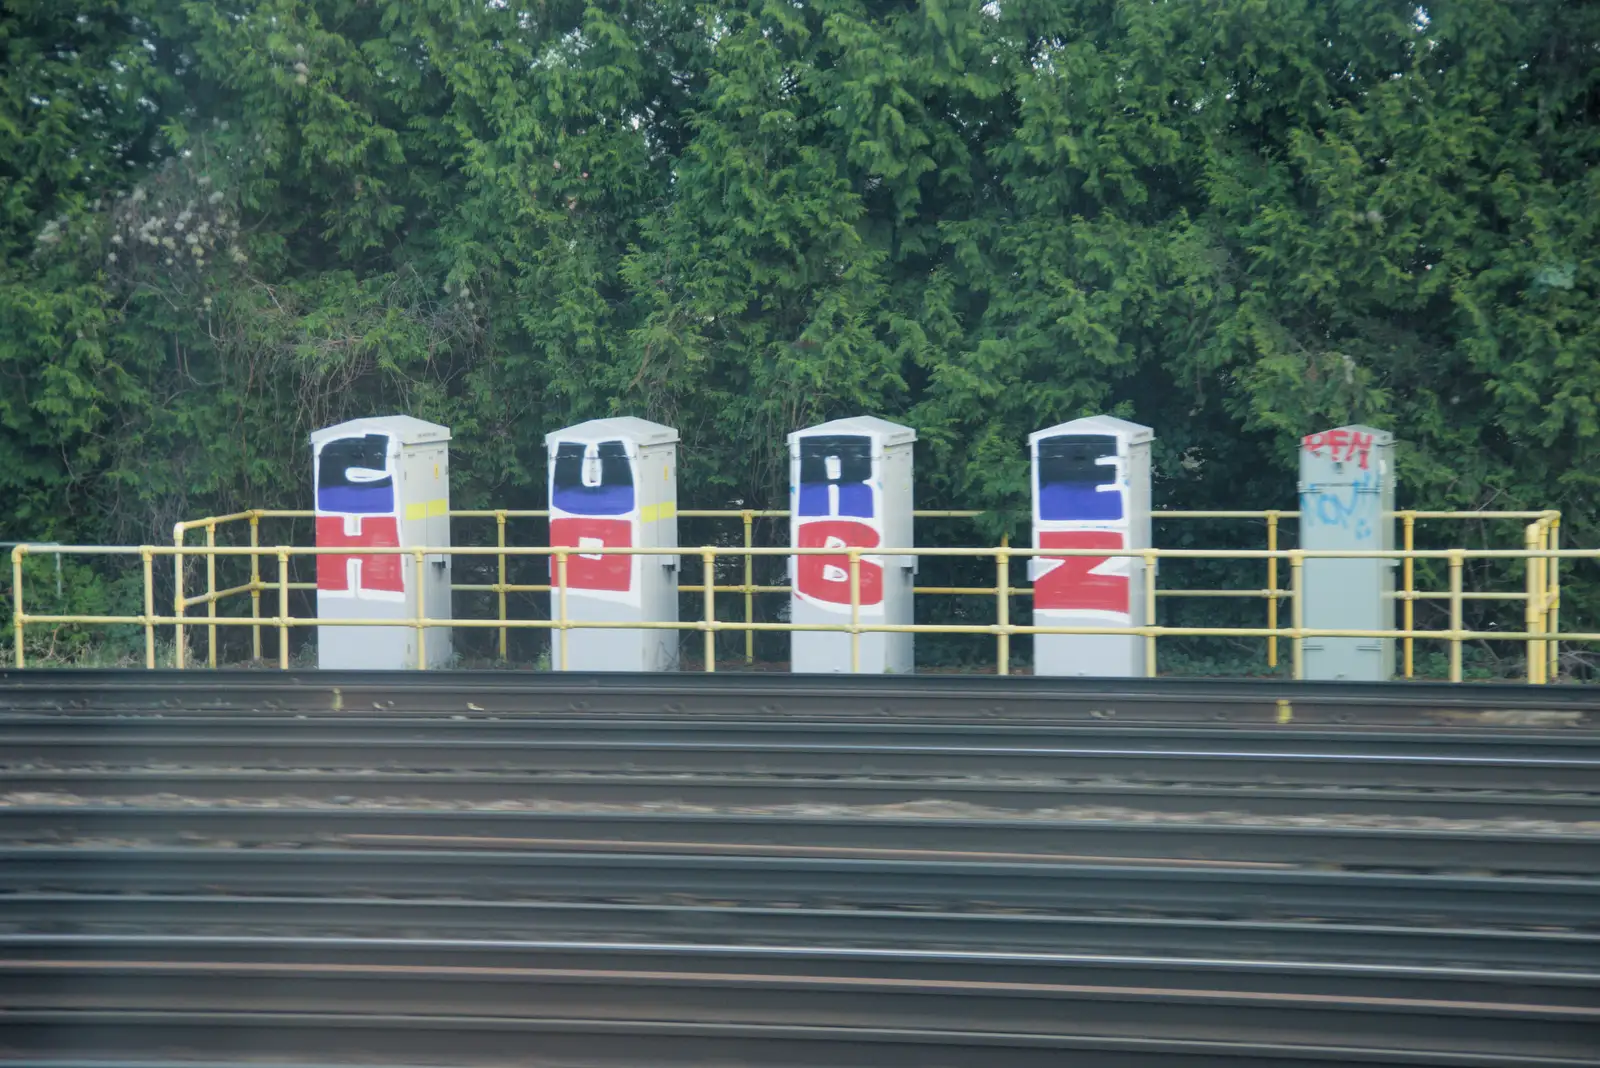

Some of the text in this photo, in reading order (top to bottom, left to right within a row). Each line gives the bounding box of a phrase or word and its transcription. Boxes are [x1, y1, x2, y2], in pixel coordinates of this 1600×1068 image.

[1037, 433, 1125, 521] E
[315, 515, 405, 593] H
[796, 519, 884, 606] B
[1034, 530, 1130, 610] Z
